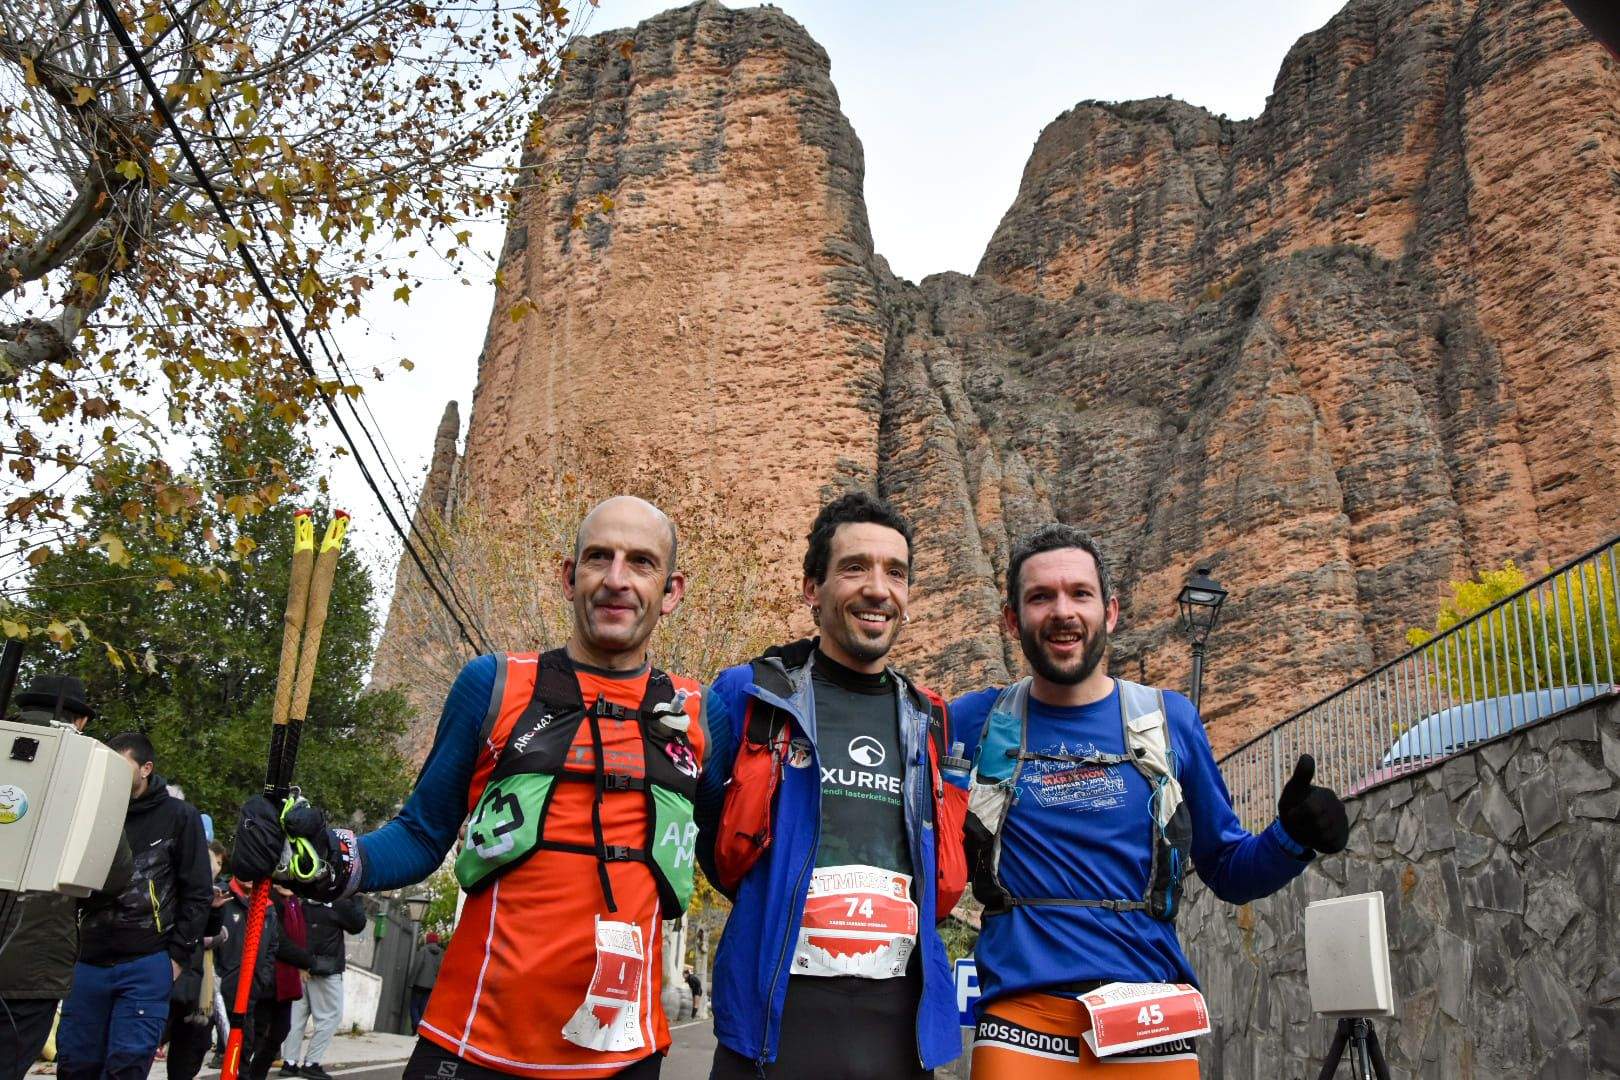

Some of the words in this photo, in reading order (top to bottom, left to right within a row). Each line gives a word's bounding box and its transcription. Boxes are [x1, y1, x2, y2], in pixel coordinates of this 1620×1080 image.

[822, 787, 843, 796] endi
[844, 897, 874, 919] 74
[1137, 1003, 1164, 1026] 45
[978, 1022, 1075, 1054] ROSSIGNOL
